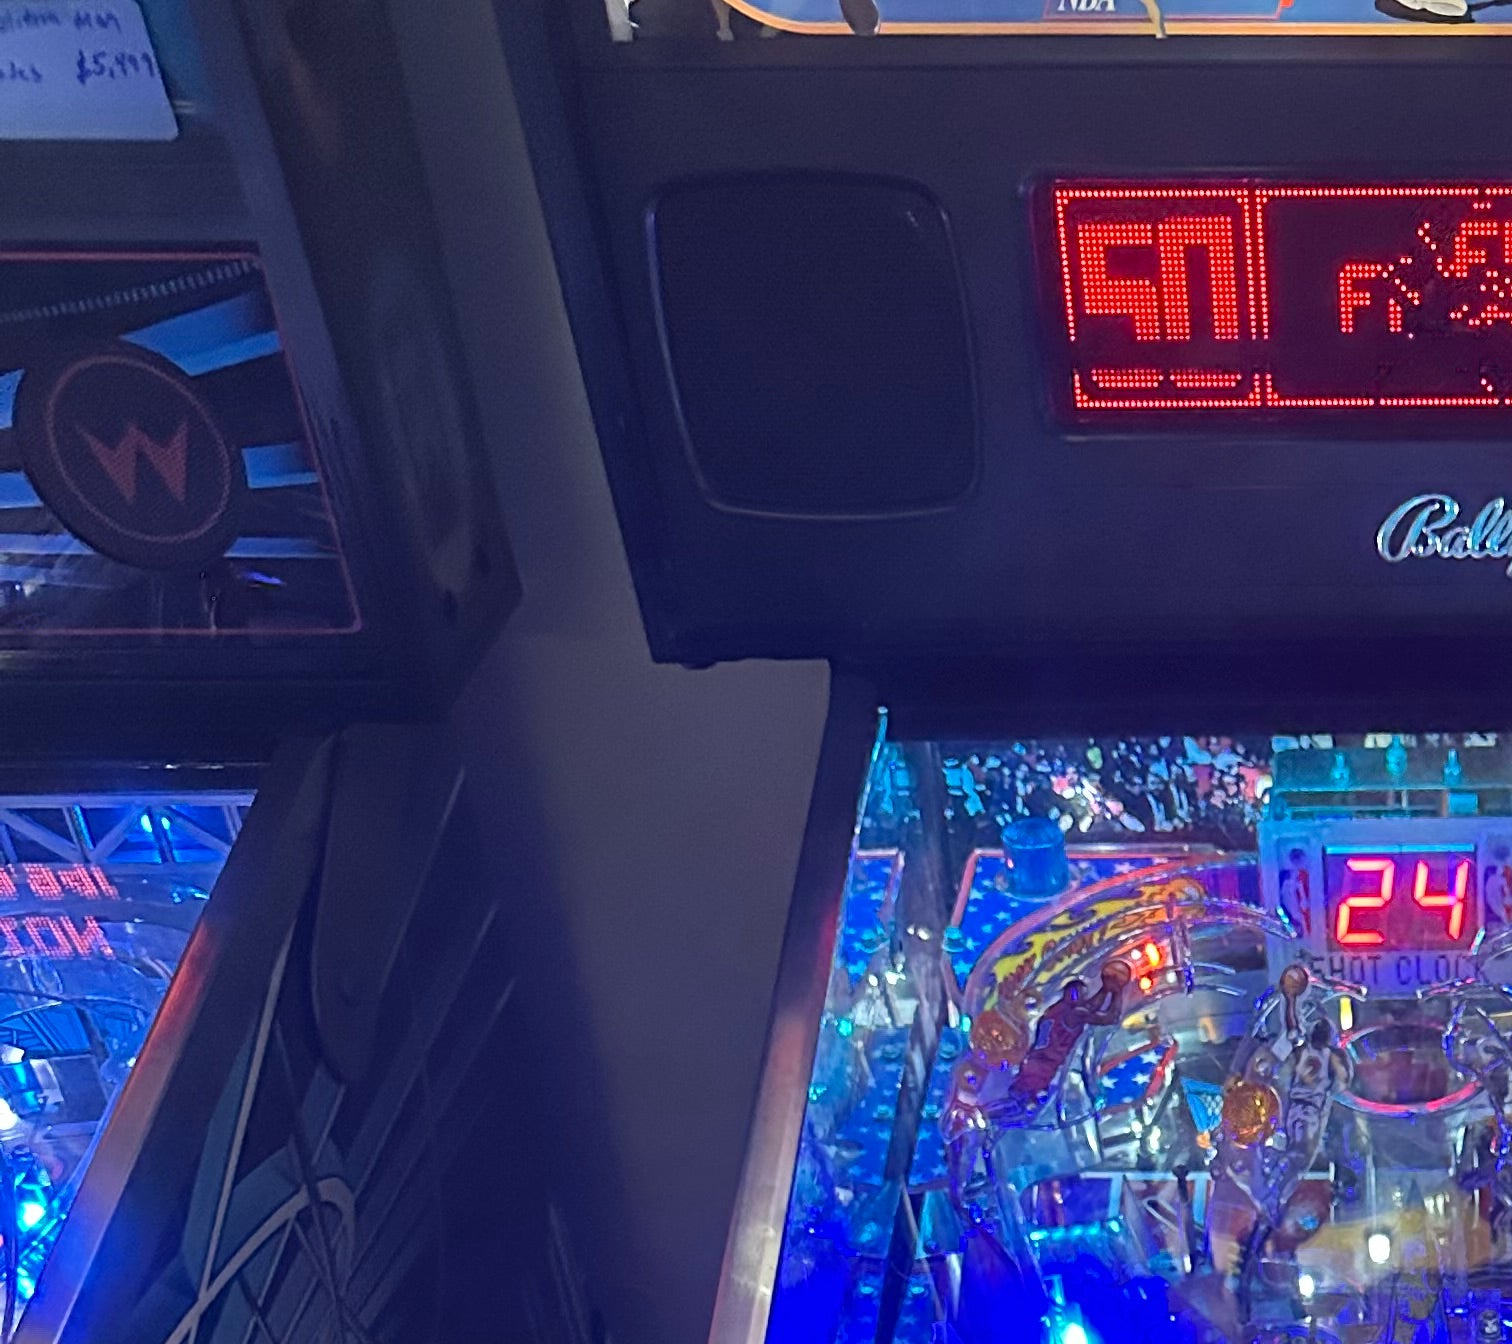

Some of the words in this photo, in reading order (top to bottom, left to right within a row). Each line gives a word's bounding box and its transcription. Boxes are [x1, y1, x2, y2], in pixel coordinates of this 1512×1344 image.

[1337, 858, 1470, 944] 24
[1311, 955, 1381, 985] SHOT
[1396, 955, 1486, 985] CLOCK
